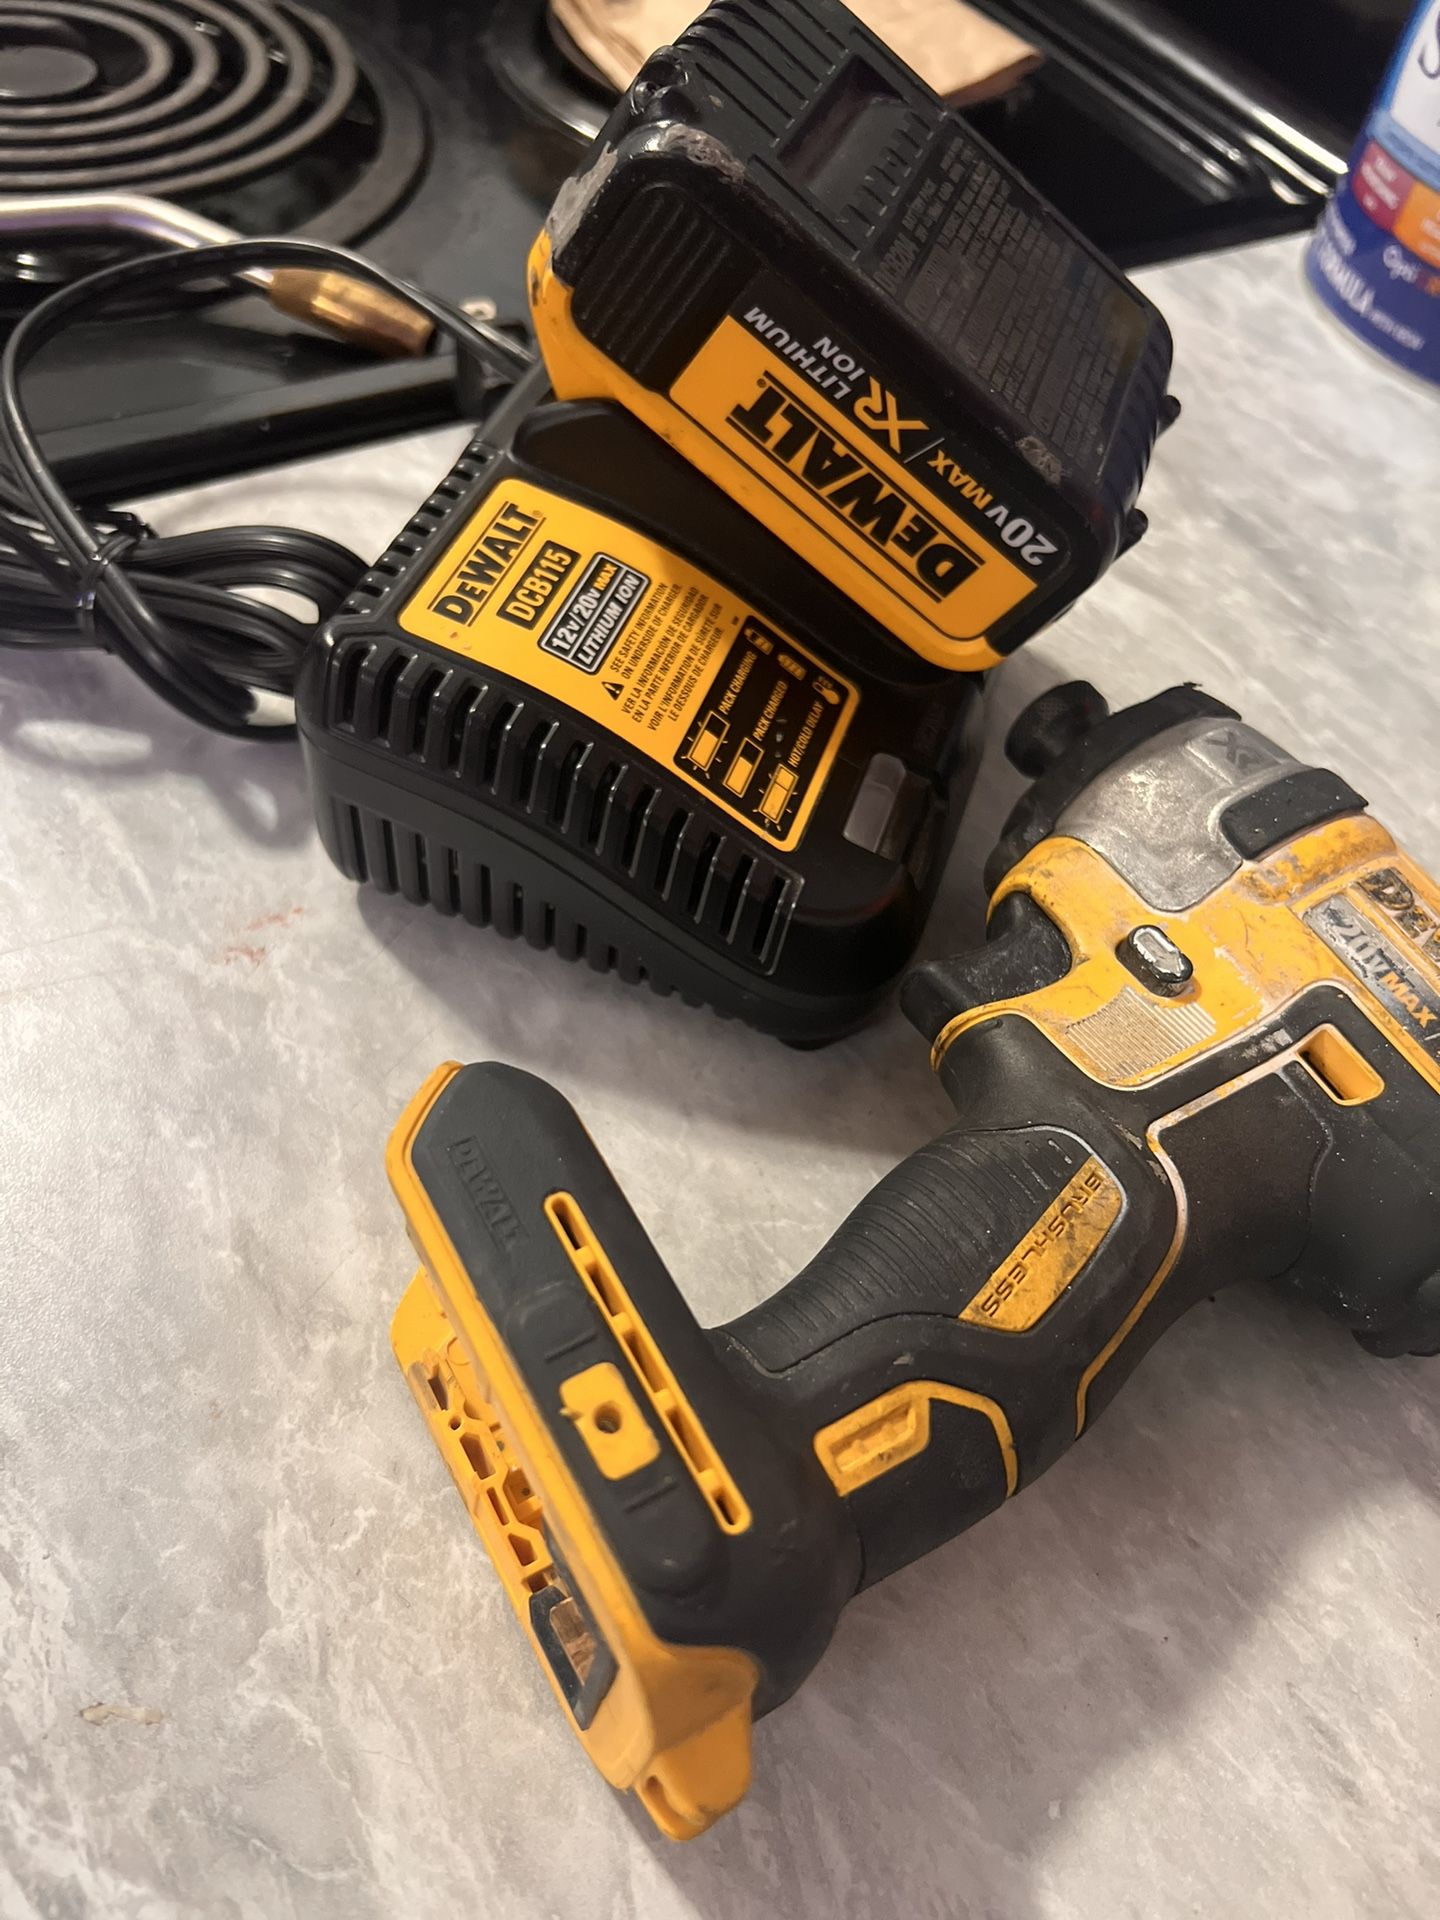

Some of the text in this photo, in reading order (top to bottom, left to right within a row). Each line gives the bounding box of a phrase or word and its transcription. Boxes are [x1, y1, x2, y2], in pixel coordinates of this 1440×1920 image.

[743, 307, 851, 399] LITHIUM
[812, 336, 865, 382] ION
[853, 376, 930, 454] XR
[730, 386, 980, 598] DEWALT
[927, 449, 1059, 567] 20V MAX
[431, 502, 539, 625] DEWALT
[506, 547, 573, 621] DCB115
[592, 562, 618, 590] MAX
[577, 574, 640, 664] LITHIUM ION
[609, 581, 668, 673] SEE SAFETY INFORMATION
[620, 664, 634, 680] ON
[627, 624, 658, 667] UNDERSIDE
[651, 614, 663, 627] OF
[621, 696, 636, 715] VER
[630, 685, 642, 699] LA
[665, 624, 677, 637] DE
[671, 585, 699, 626] SEGURIDAD
[676, 630, 688, 643] DE
[644, 674, 664, 700] PARTE
[647, 710, 664, 731] VOIR
[657, 654, 694, 712] L'INFORMATION
[688, 644, 700, 656] DE
[709, 602, 722, 619] SUR
[658, 641, 682, 676] INFERIOR
[691, 664, 703, 676] DE
[717, 650, 757, 715] PACK CHARGING
[631, 708, 645, 723] EN
[638, 698, 651, 711] LA
[667, 709, 679, 721] LE
[672, 674, 697, 711] DESSOUS
[752, 679, 788, 741] PACK CHARGED
[787, 700, 824, 767] HOT/COLD DELAY
[1380, 970, 1438, 1028] MAX
[980, 1171, 1106, 1317] BRUSHLESS
